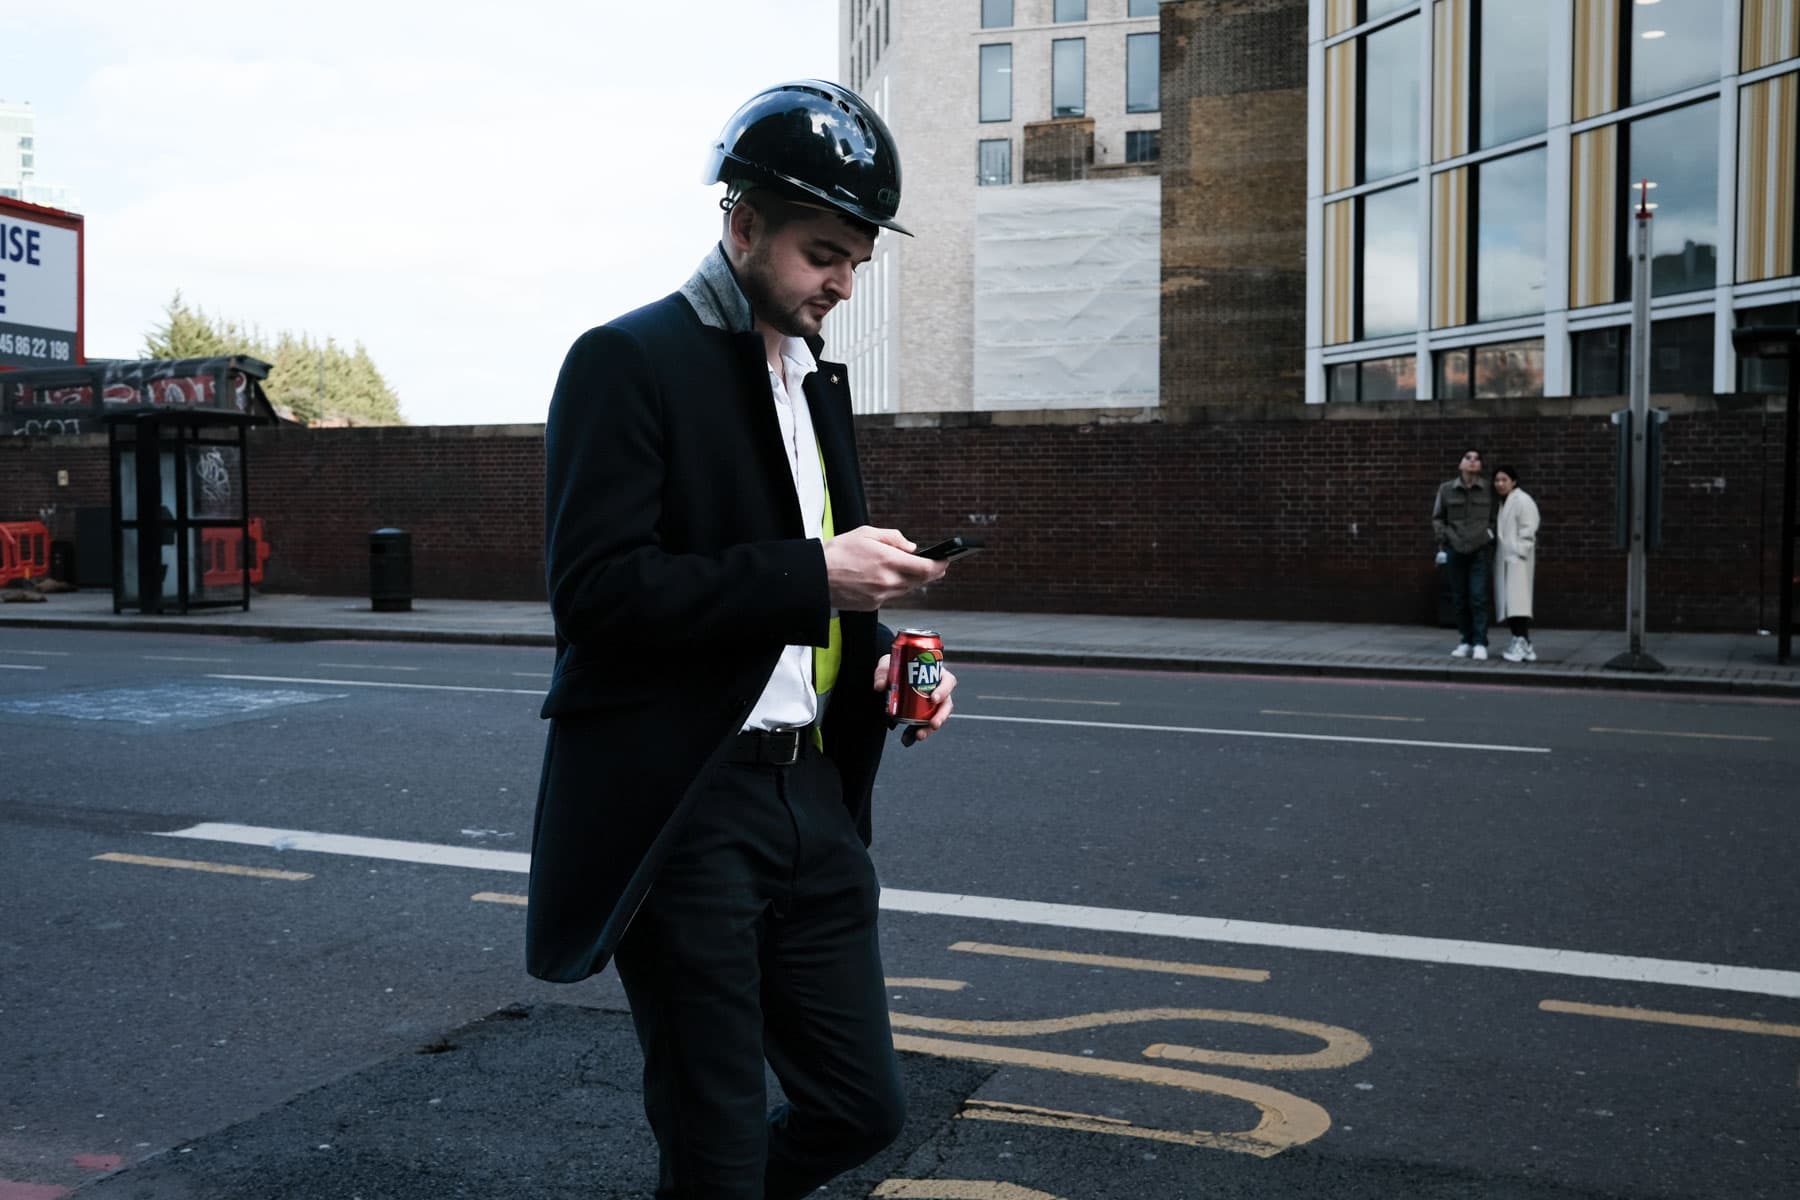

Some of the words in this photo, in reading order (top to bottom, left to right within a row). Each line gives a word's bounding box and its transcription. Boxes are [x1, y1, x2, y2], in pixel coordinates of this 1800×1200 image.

[1, 223, 40, 266] ISE
[0, 333, 14, 354] 45
[15, 335, 31, 356] 86
[32, 337, 47, 358] 22
[50, 340, 69, 361] 198
[907, 661, 943, 684] FAN
